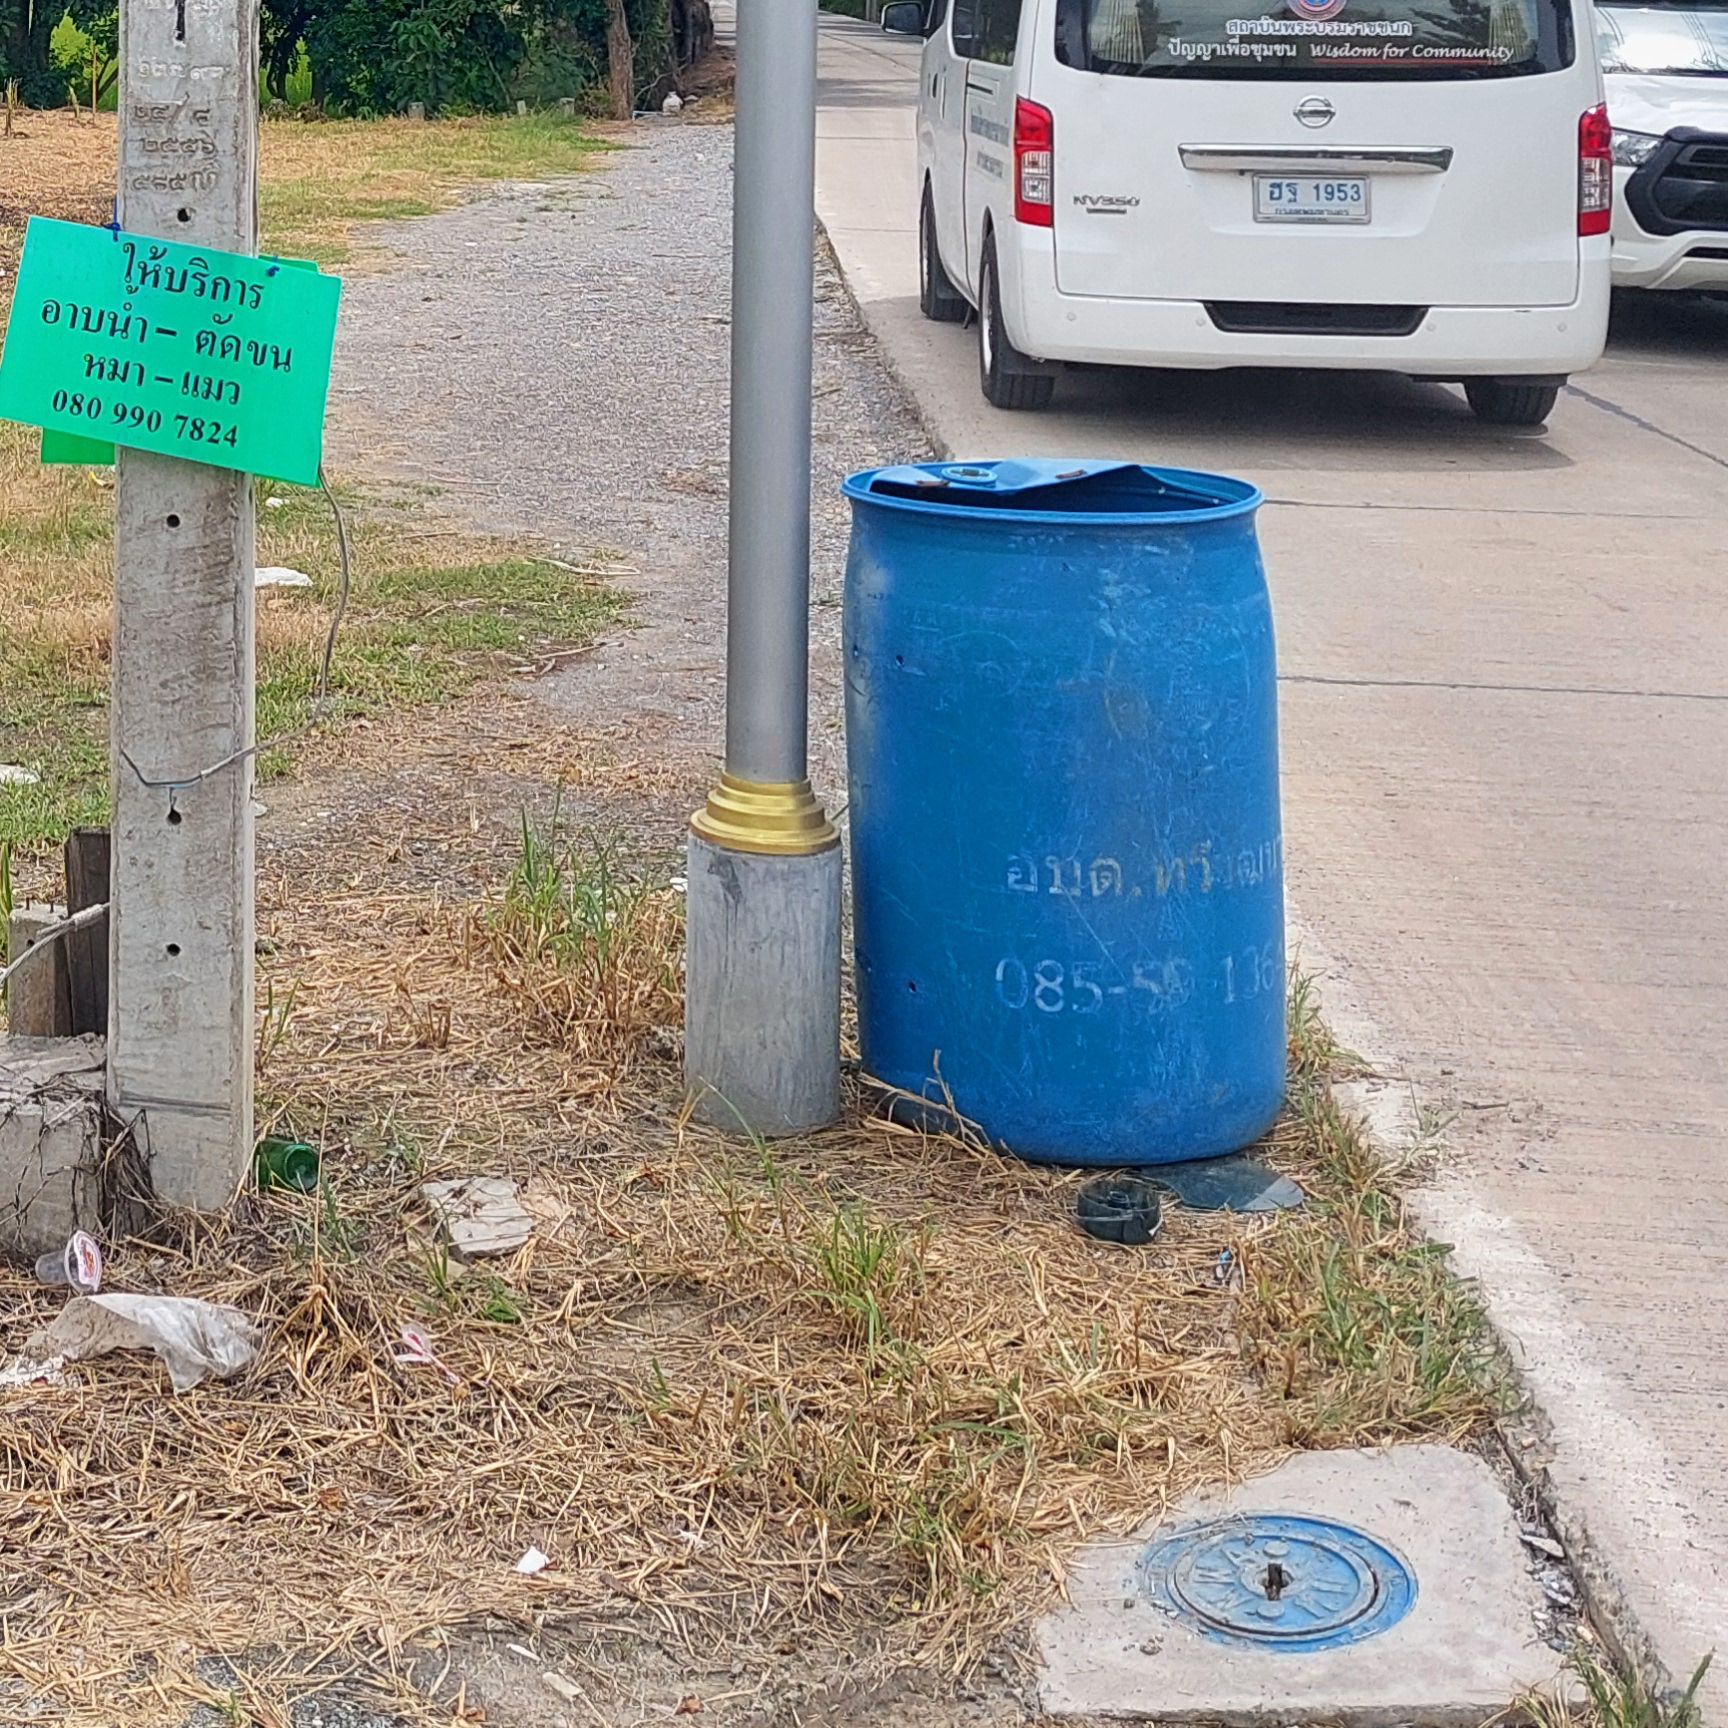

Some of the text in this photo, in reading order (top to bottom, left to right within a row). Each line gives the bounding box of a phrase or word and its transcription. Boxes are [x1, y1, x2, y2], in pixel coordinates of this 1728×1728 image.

[1168, 28, 1297, 61] ปัญญาเพื่อชุมชน
[1311, 43, 1514, 61] Wisdom for Community
[1073, 195, 1140, 207] NV350
[1313, 182, 1362, 202] 1953
[122, 242, 264, 310] ให้บริการ
[195, 313, 292, 373] ตัดขน
[52, 389, 238, 448] 080 990 7824
